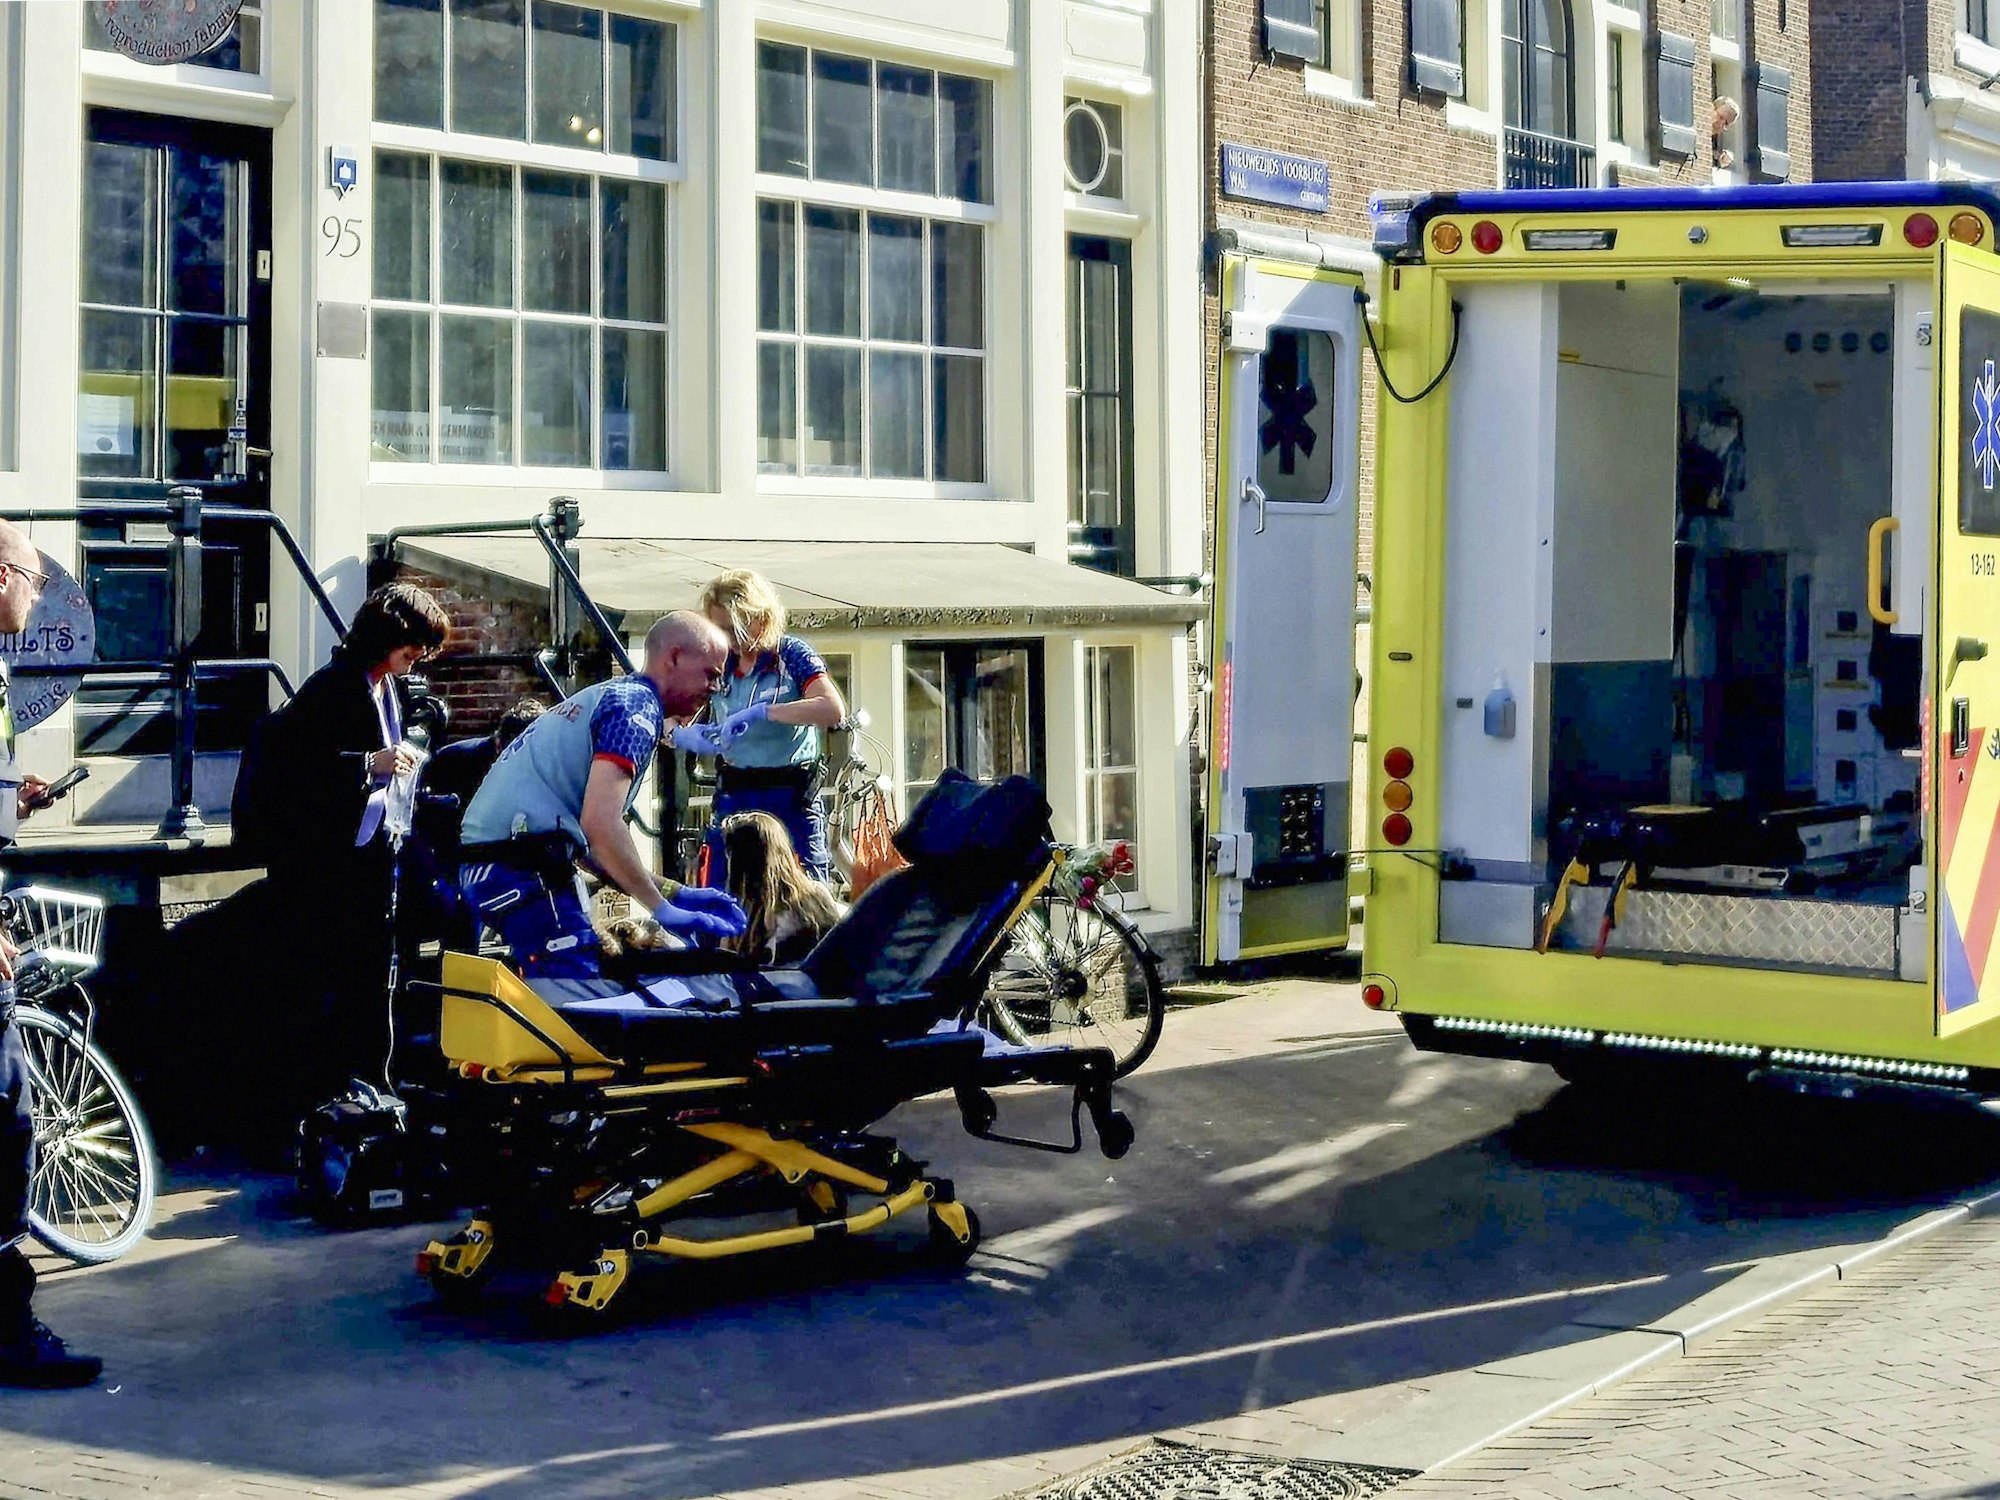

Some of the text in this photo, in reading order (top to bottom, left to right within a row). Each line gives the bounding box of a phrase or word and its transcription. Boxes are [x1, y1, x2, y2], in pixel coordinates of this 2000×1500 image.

[104, 16, 191, 58] reproduction
[1228, 149, 1324, 185] NIEUWEZIJDS VOORBURG
[1229, 169, 1247, 190] WAL
[1300, 189, 1324, 204] CENTRUM
[322, 215, 362, 258] 95
[1971, 553, 1995, 576] 13-162
[15, 682, 68, 722] abric
